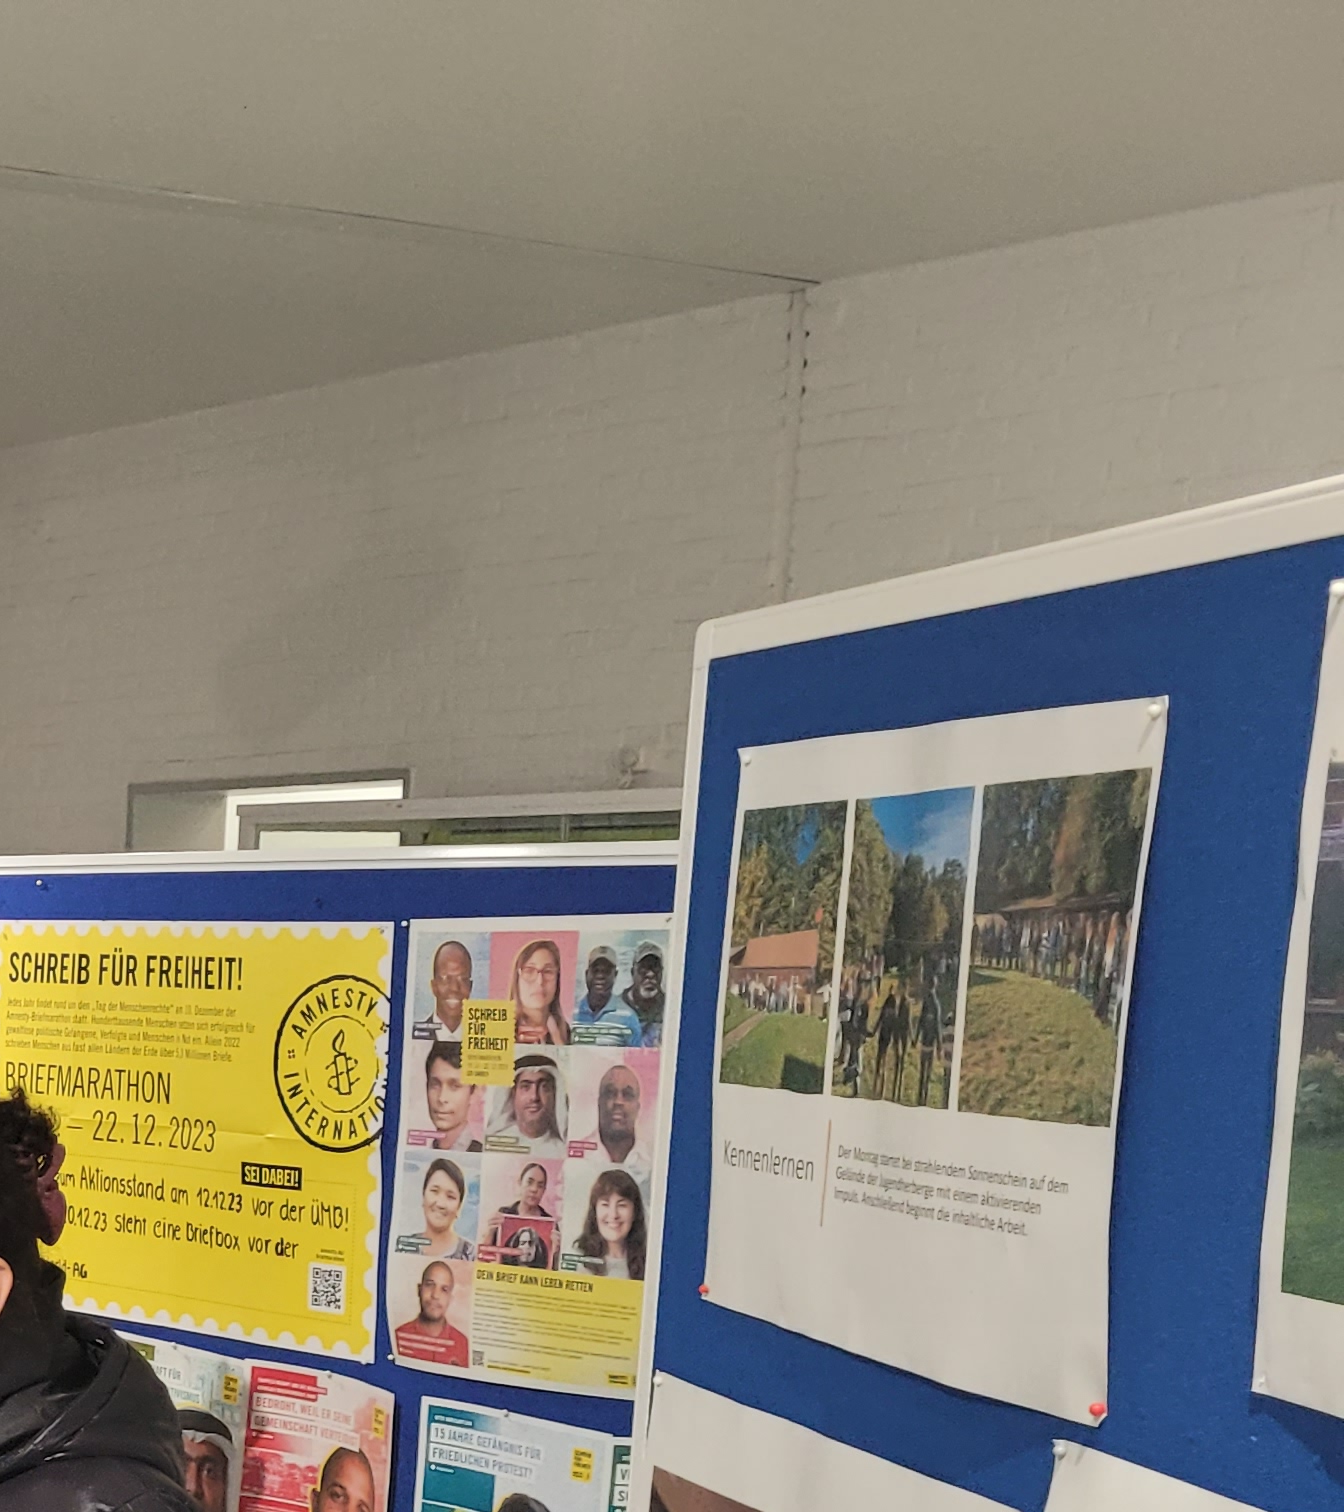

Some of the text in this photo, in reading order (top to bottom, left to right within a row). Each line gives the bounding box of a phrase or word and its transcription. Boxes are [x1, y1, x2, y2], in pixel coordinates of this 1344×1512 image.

[9, 947, 243, 991] SCHREIB FÜR FREIHEIT!
[78, 1000, 90, 1010] den
[291, 988, 378, 1039] AMNESTY
[468, 1007, 508, 1022] SCHREIB
[468, 1021, 486, 1036] FÜR
[72, 1042, 86, 1052] fast
[224, 1037, 240, 1048] 2022
[467, 1036, 509, 1051] FREIHEIT
[5, 1061, 171, 1105] BRIEFMARATHON
[724, 1139, 815, 1182] Kennenlernen
[838, 1145, 852, 1159] Der
[1030, 1174, 1047, 1190] auf
[1047, 1176, 1069, 1194] dem
[244, 1165, 299, 1188] SEI DABEI!
[56, 1172, 75, 1188] um
[80, 1164, 164, 1202] Aktionsstand
[170, 1187, 189, 1206] am
[196, 1187, 243, 1214] 12.12.23
[252, 1197, 274, 1219] vor
[279, 1197, 306, 1223] der
[153, 1217, 181, 1241] eine
[186, 1221, 240, 1250] Briefbox
[248, 1234, 273, 1256] vor
[275, 1237, 299, 1260] der
[476, 1269, 494, 1281] DEIN
[496, 1272, 518, 1284] BRIEF
[254, 1415, 318, 1436] GEMEINSCHAFT
[434, 1427, 445, 1440] 15
[448, 1428, 474, 1445] JAHRE
[432, 1447, 490, 1469] FRIEDLICHEN
